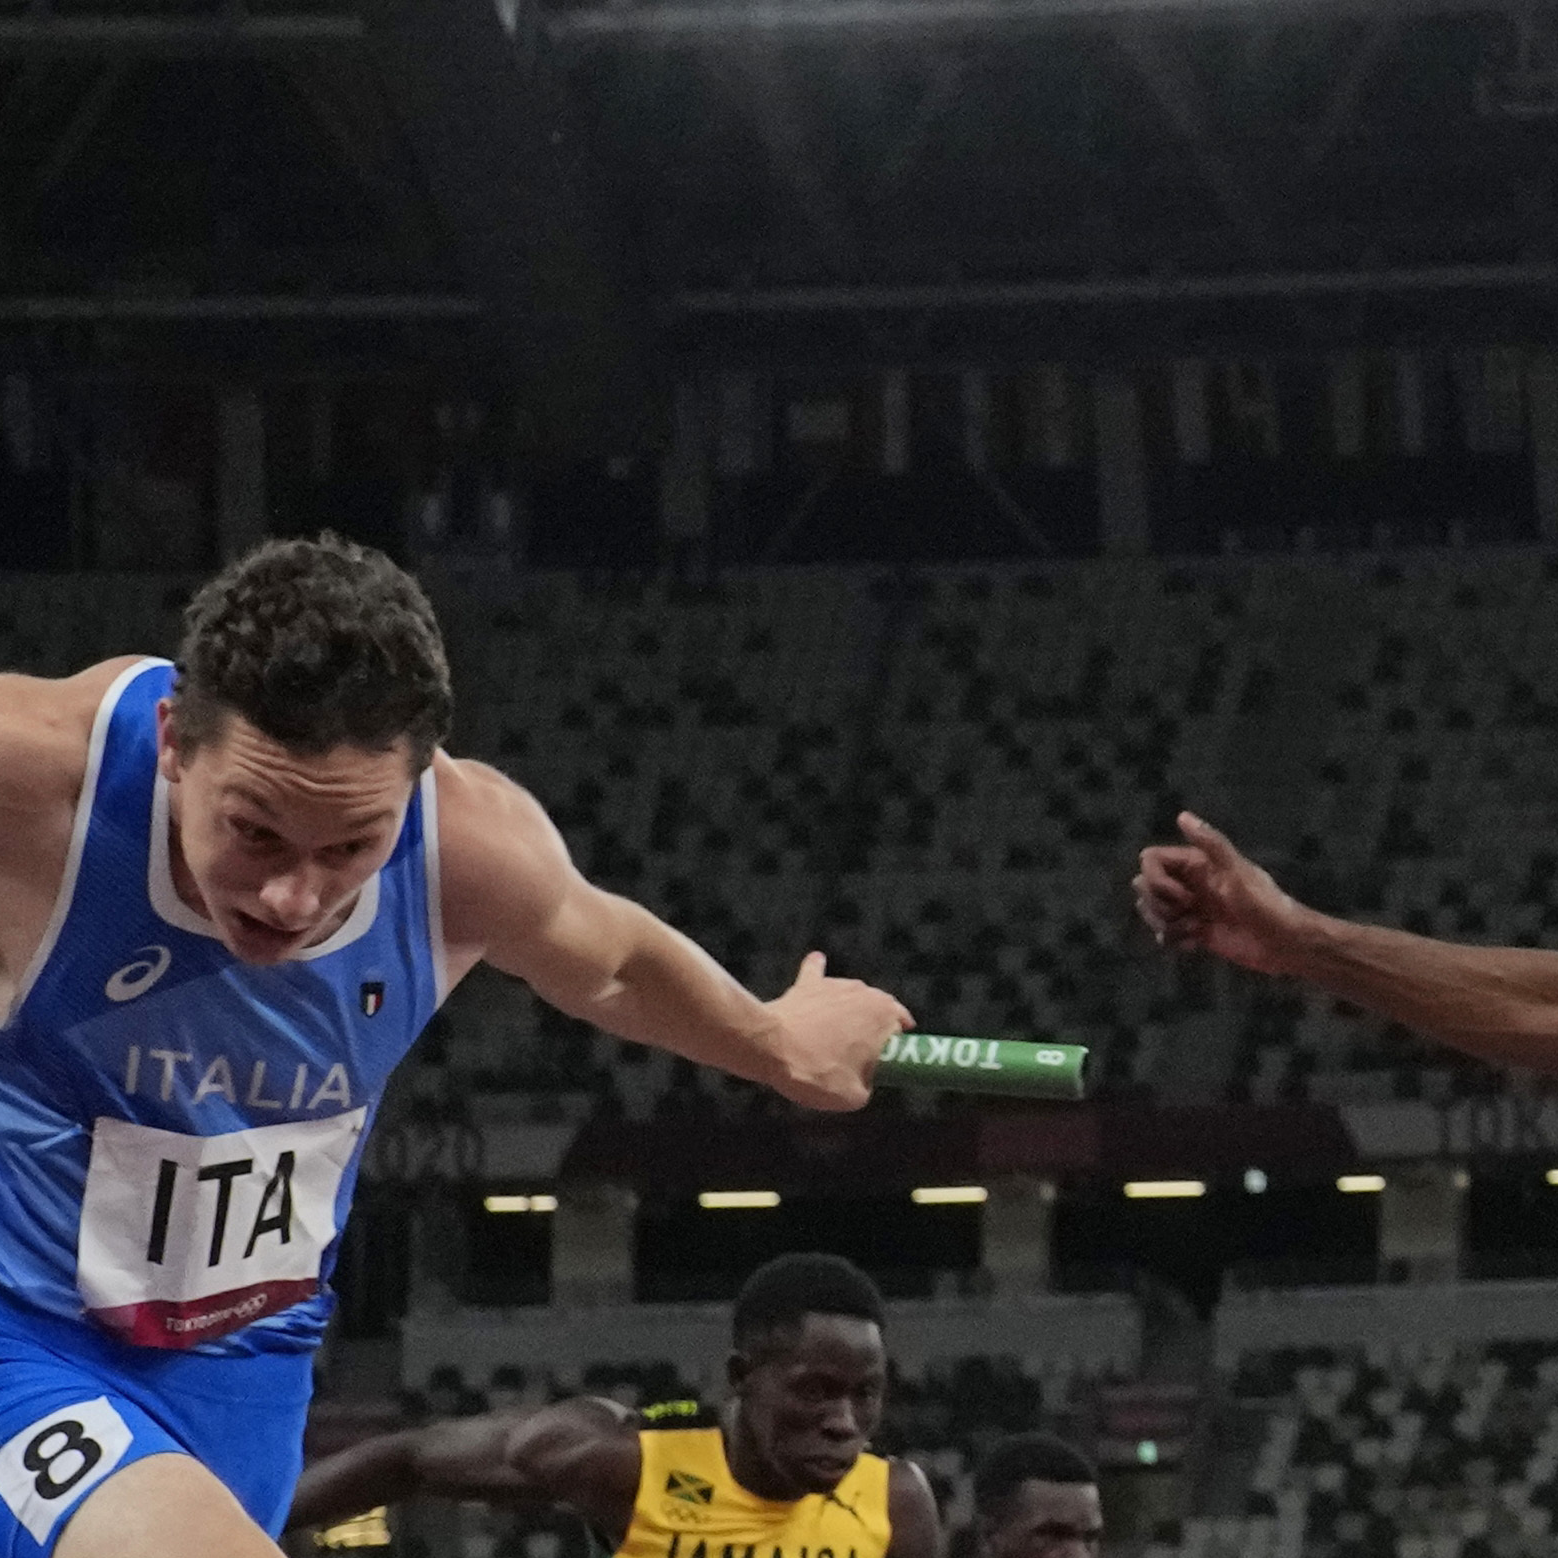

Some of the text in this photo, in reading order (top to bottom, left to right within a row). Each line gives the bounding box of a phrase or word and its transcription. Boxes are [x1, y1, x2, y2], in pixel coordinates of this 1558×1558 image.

[125, 1045, 352, 1110] ITALIA
[1034, 1049, 1067, 1067] 8
[146, 1151, 296, 1267] ITA
[23, 1420, 103, 1500] 8
